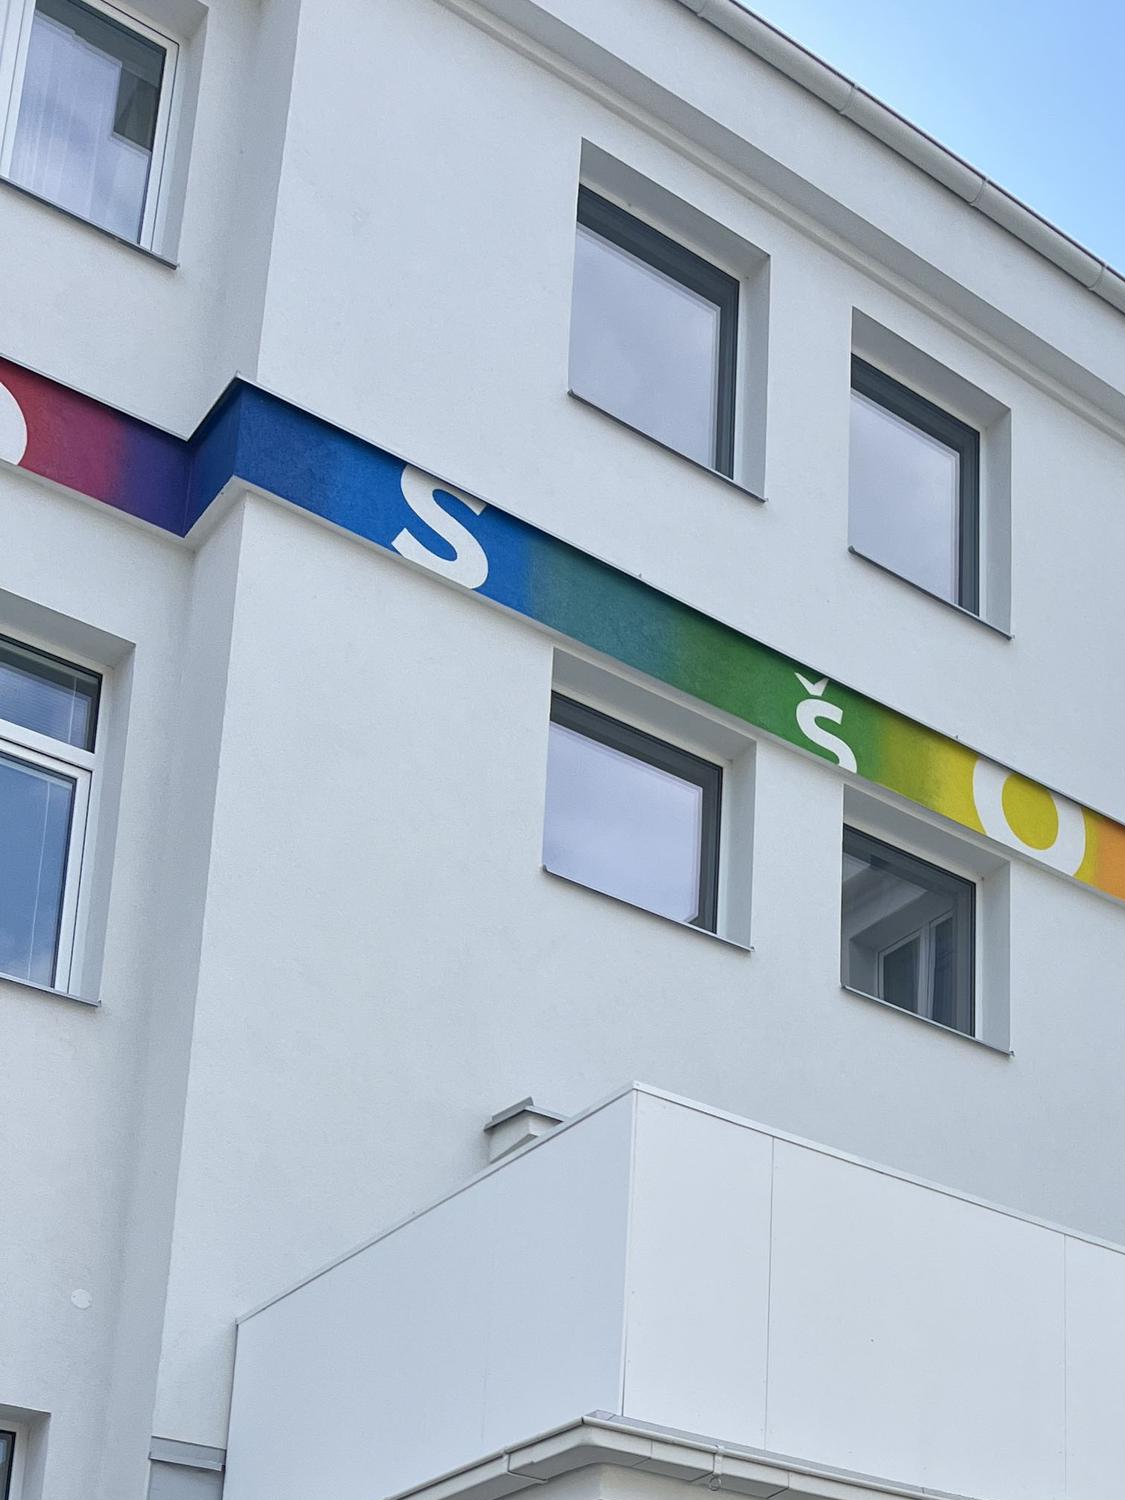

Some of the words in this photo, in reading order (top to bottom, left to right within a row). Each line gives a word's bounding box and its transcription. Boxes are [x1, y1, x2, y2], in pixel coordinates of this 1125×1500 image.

[391, 464, 489, 590] S
[795, 671, 858, 775] Š
[972, 758, 1087, 878] O
